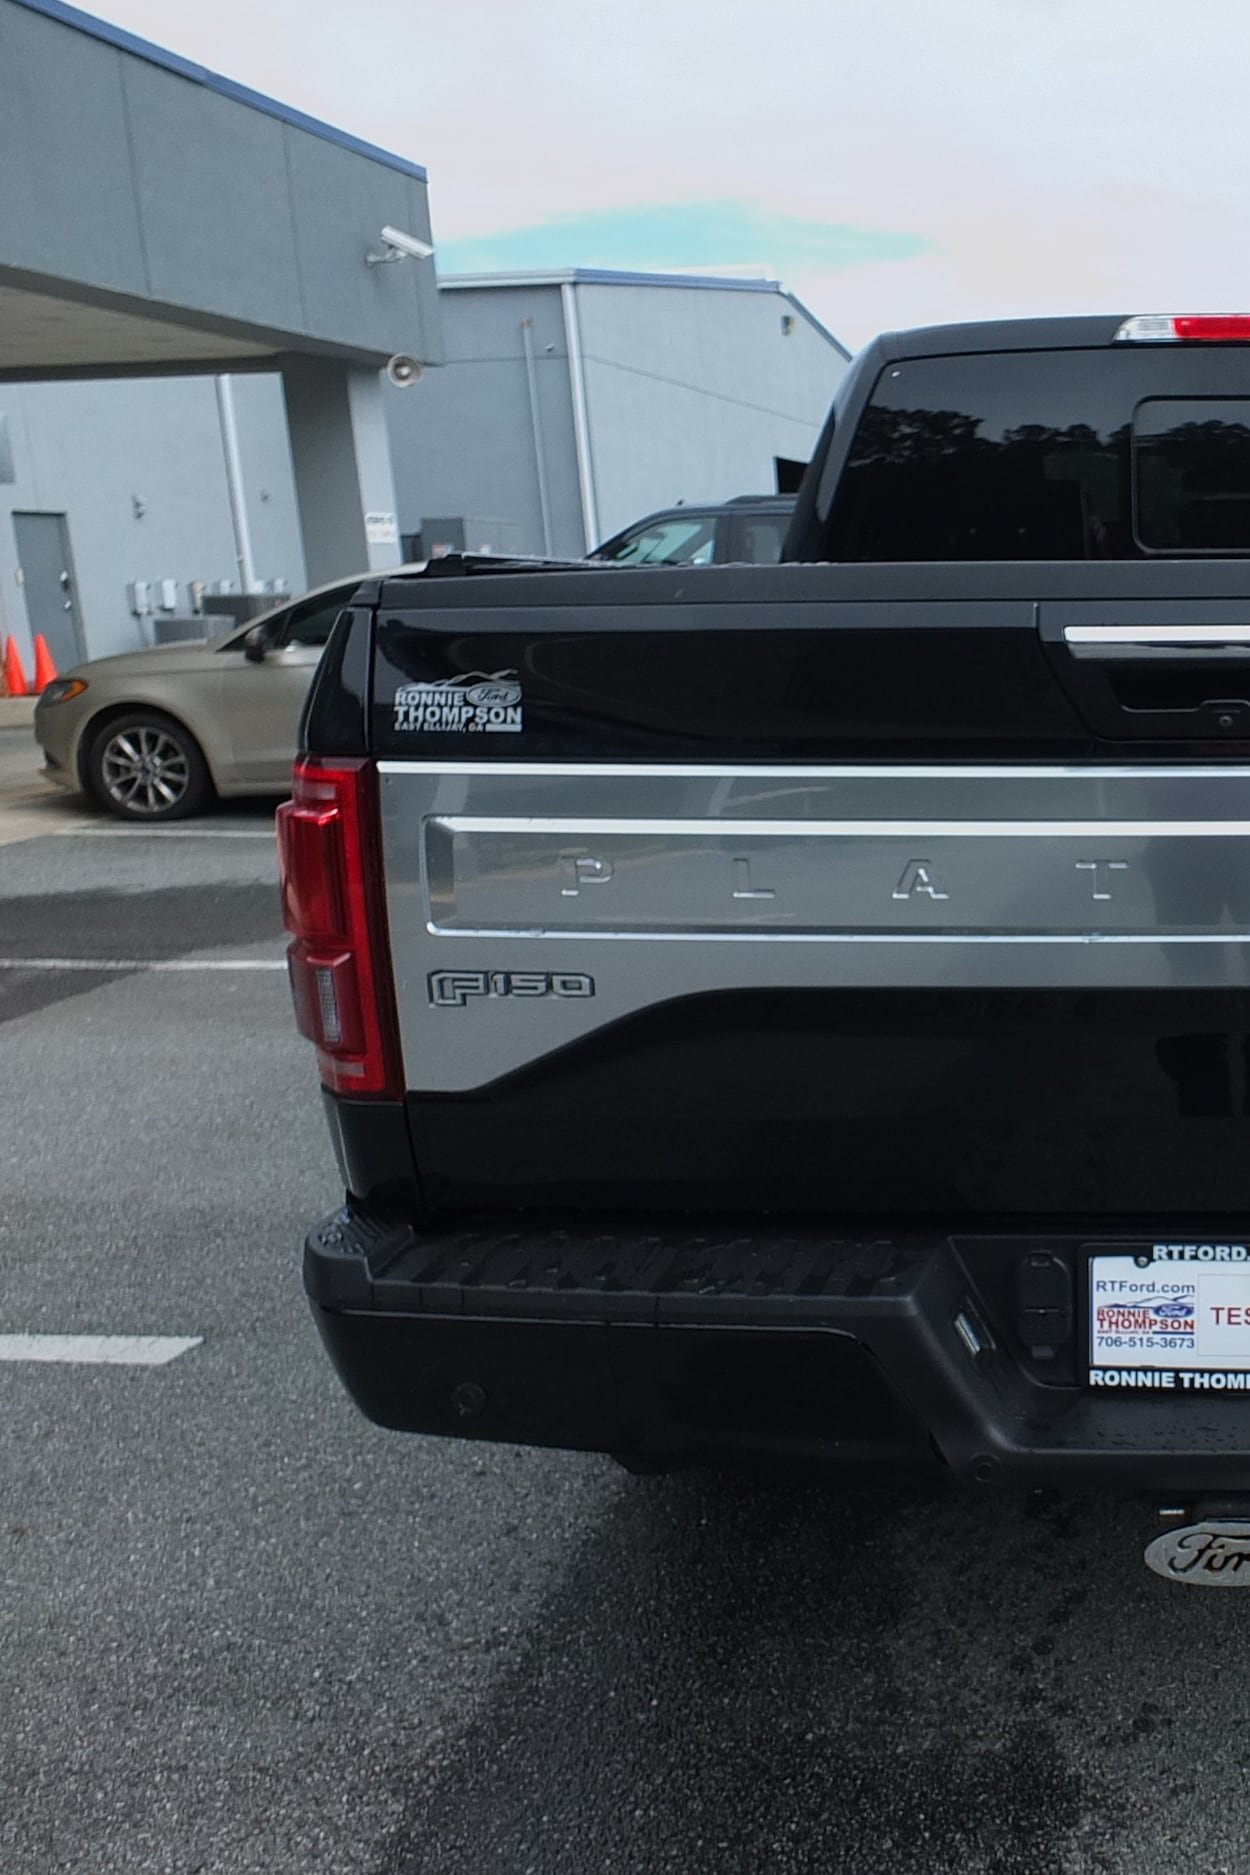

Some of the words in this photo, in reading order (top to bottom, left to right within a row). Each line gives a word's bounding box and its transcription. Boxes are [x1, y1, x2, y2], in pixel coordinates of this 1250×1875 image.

[394, 691, 465, 706] RONNIE
[393, 706, 522, 724] THOMPSON
[1096, 1280, 1195, 1293] RTFord.com
[1097, 1309, 1150, 1319] RONNIE
[1158, 1305, 1188, 1317] Ford
[1097, 1318, 1195, 1330] THOMPSON
[1097, 1336, 1195, 1349] 706-515-3673
[1089, 1369, 1175, 1388] RONNIE
